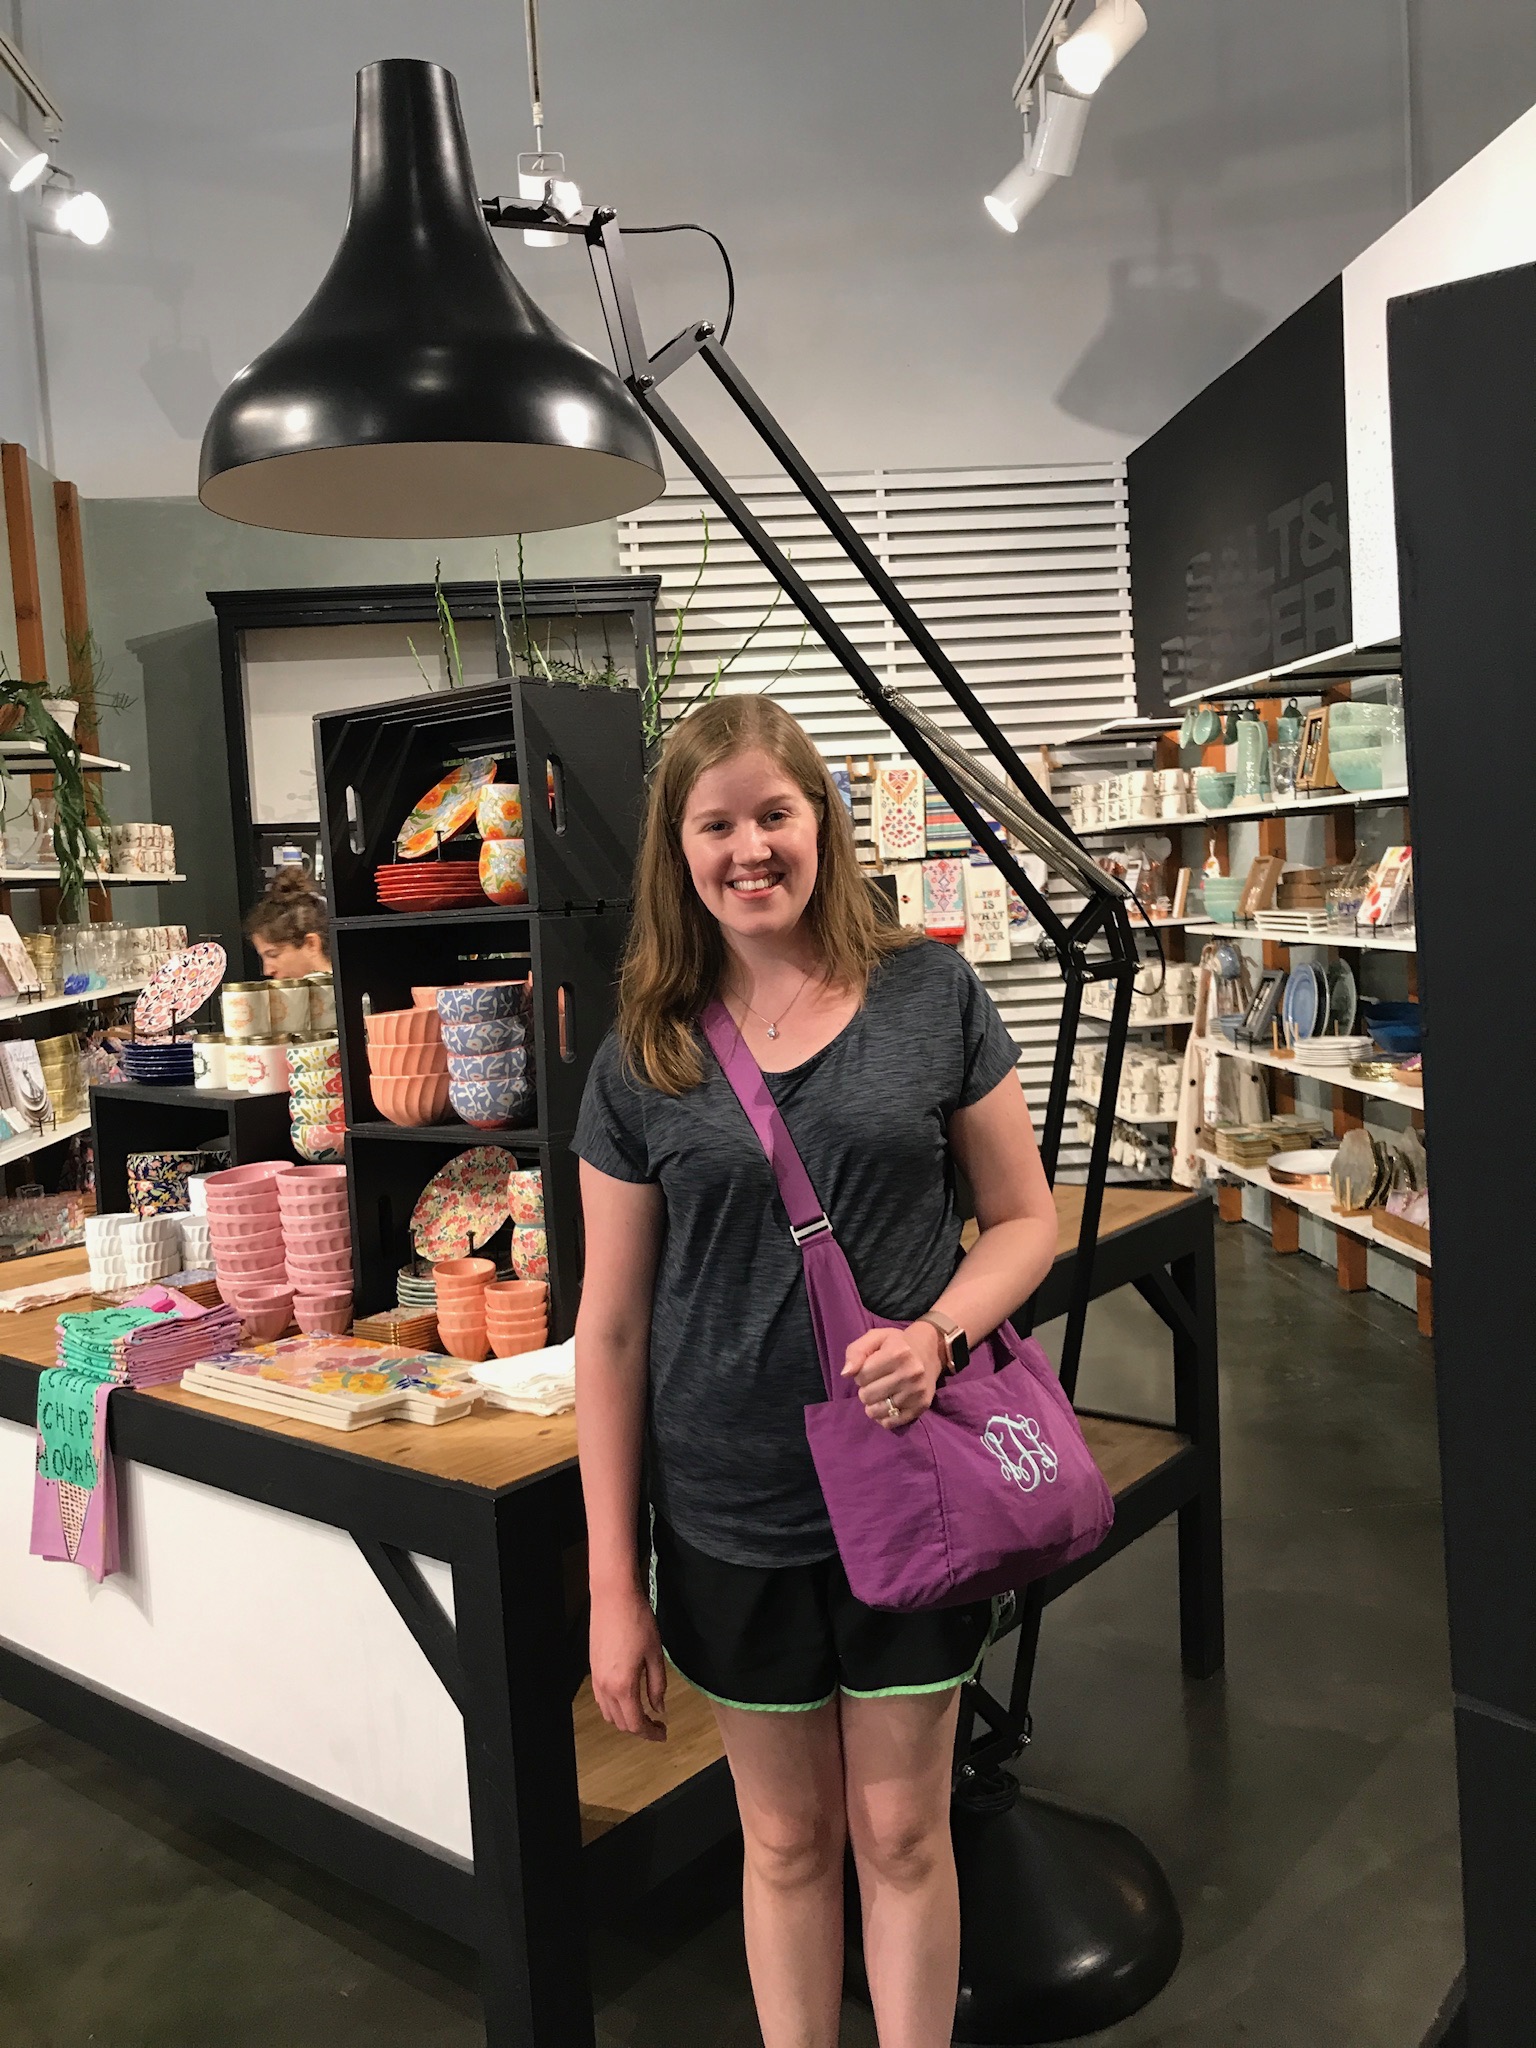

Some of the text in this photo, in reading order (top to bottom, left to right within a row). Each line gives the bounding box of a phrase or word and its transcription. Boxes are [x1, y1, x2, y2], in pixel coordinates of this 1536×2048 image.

[983, 900, 995, 910] IS
[971, 911, 1005, 921] WHAT
[978, 921, 1001, 931] YOU
[985, 943, 998, 952] IT
[42, 1401, 89, 1439] CHIP
